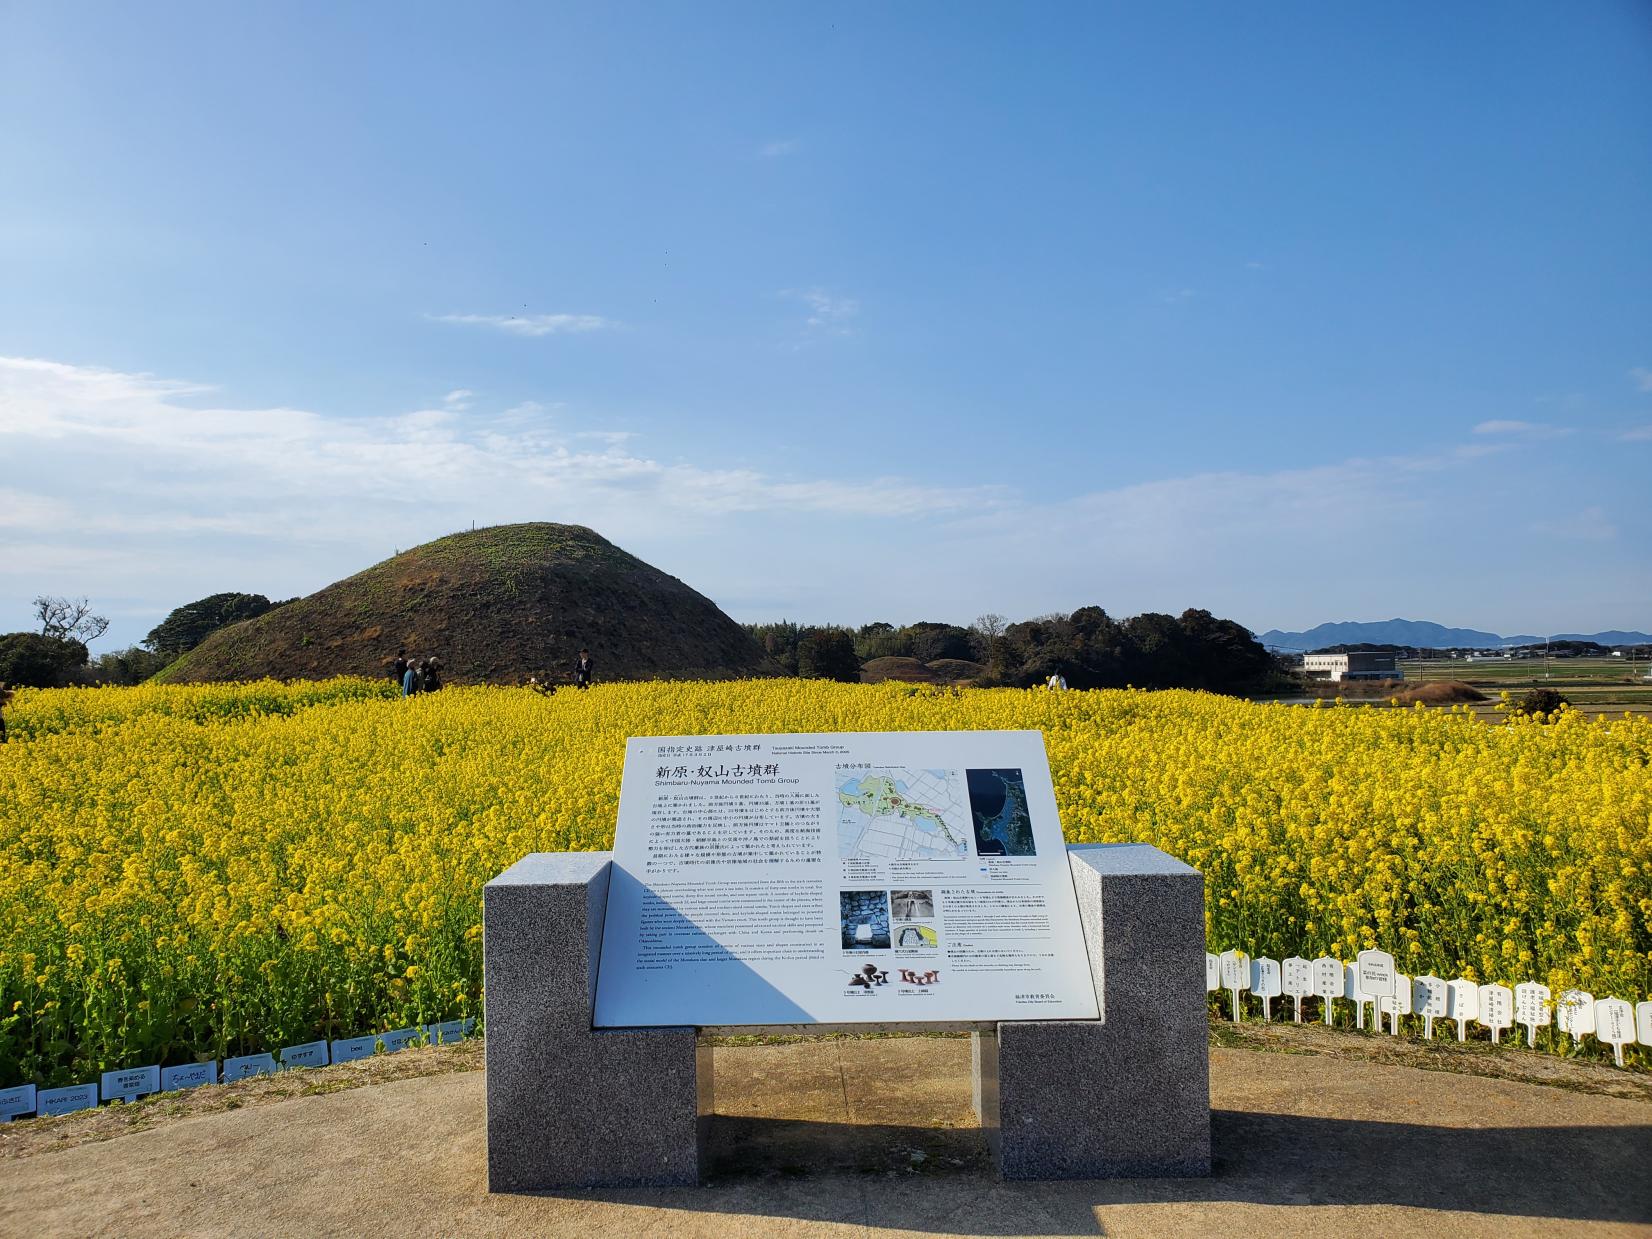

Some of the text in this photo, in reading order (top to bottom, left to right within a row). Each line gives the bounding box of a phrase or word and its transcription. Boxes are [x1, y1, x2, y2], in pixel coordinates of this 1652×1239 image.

[658, 744, 761, 753] 国指定史跡 津屋崎古墳群
[656, 763, 780, 778] 新原・奴山古墳群
[45, 1094, 88, 1105] HIKARI 2023
